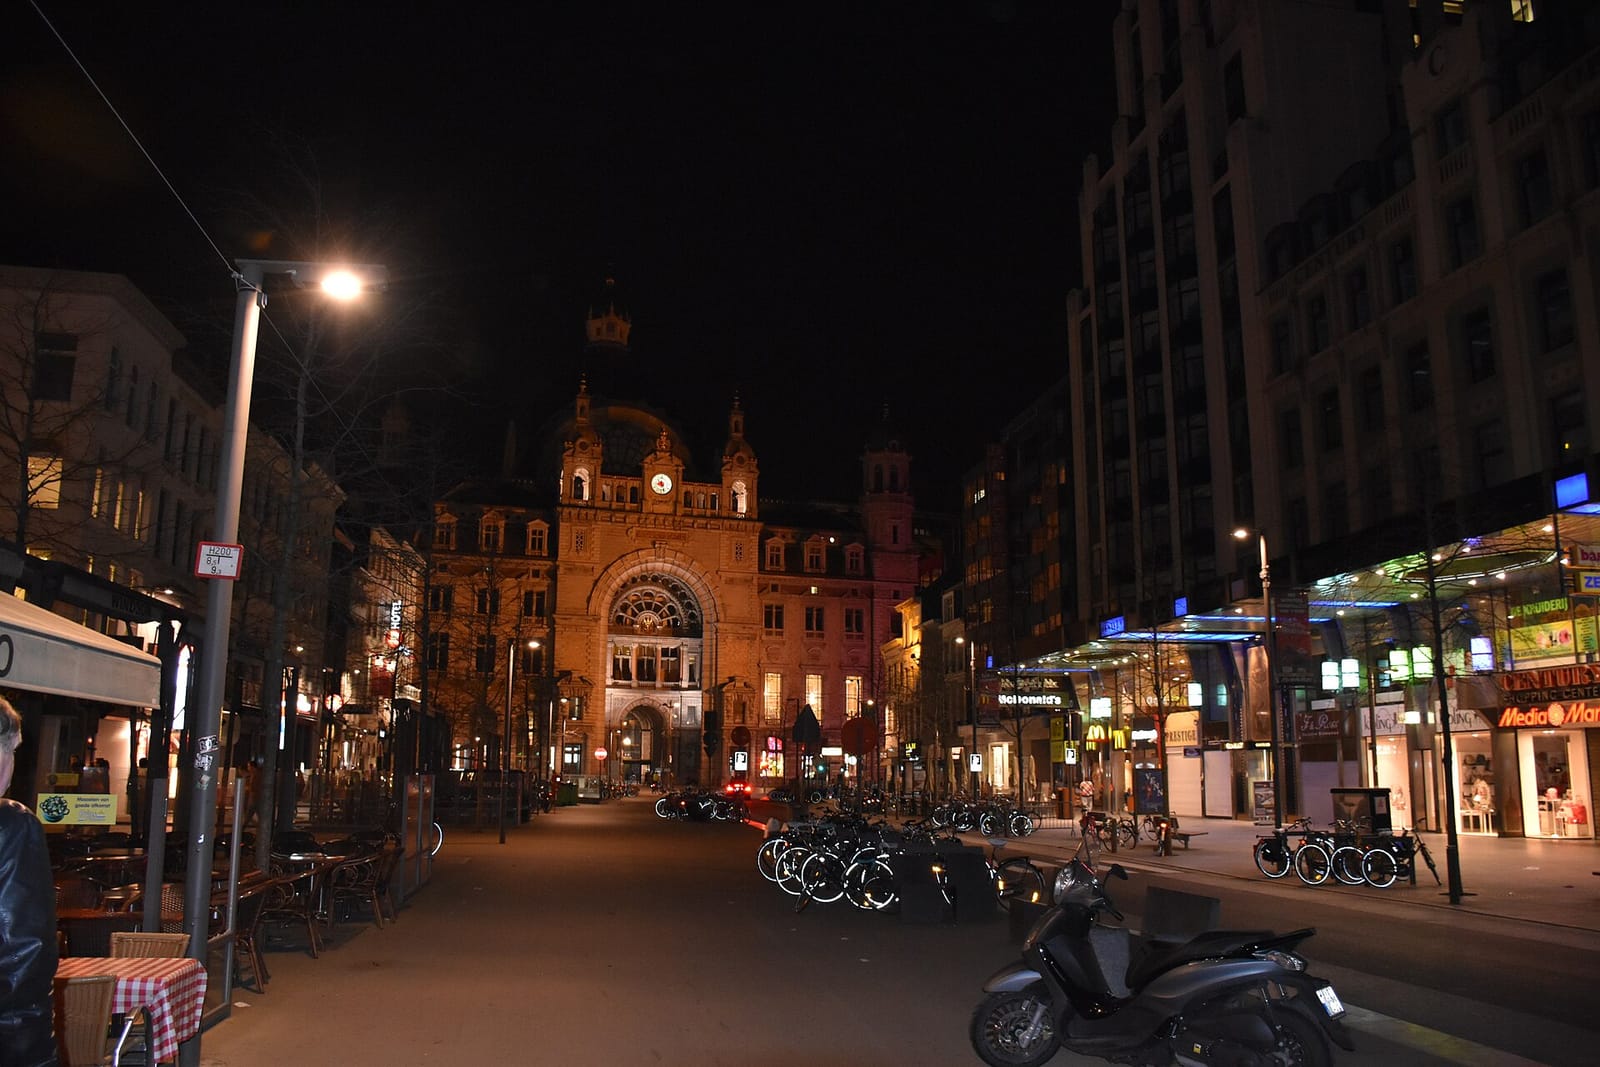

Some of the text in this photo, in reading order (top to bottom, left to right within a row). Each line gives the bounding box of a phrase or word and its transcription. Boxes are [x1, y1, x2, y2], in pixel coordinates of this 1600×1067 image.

[208, 546, 232, 556] H200
[390, 599, 402, 630] HOTEL
[1498, 707, 1548, 728] Media
[1165, 729, 1196, 744] PRESTIGE
